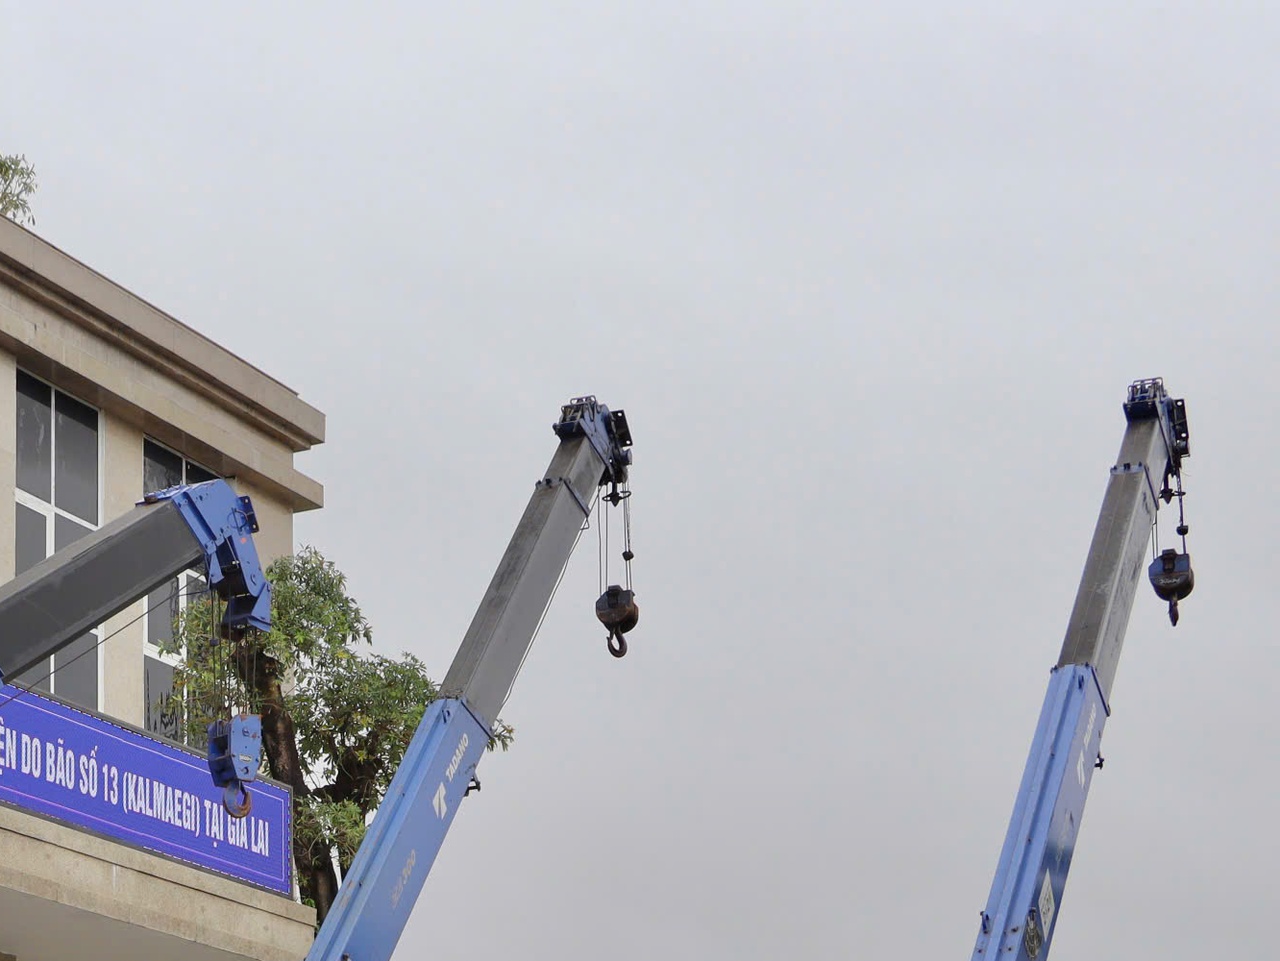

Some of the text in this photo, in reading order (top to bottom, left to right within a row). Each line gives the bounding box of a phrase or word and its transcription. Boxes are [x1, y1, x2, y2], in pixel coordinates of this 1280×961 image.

[21, 733, 42, 779] DO
[46, 738, 75, 790] BÃO
[79, 745, 98, 798] SỐ
[102, 763, 119, 805] 13
[122, 772, 200, 837] (KALMAEGI)
[204, 799, 224, 848] TẠI
[227, 812, 248, 850] GIA
[251, 816, 269, 857] LAI
